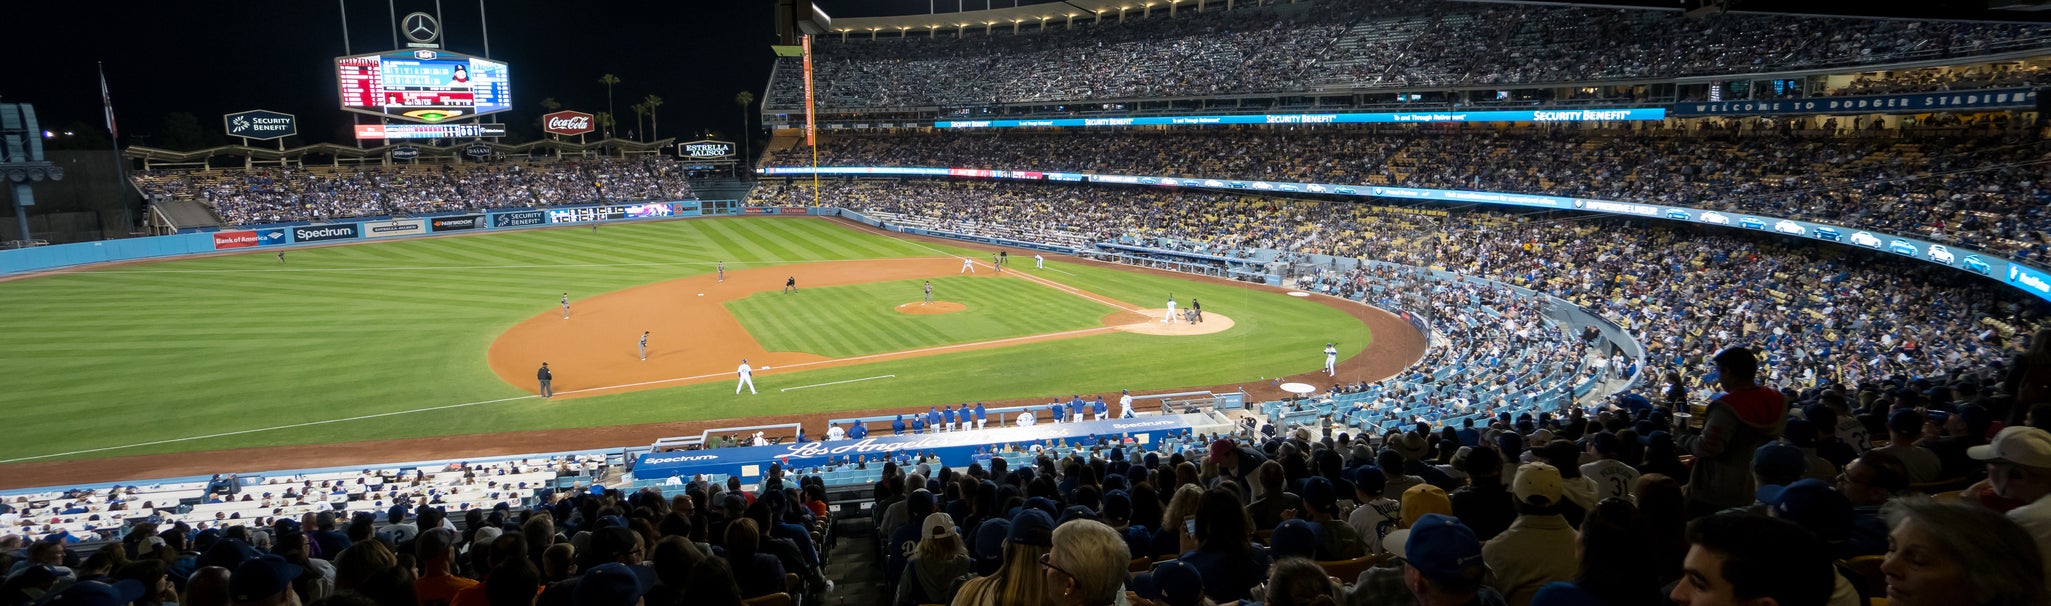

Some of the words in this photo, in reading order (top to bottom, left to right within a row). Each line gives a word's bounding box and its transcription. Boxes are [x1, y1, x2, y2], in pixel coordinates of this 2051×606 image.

[1696, 103, 1780, 112] WELCOME
[1795, 102, 1814, 110] TO
[1830, 98, 1909, 109] DODGER
[1925, 92, 2026, 106] STADIUM
[1266, 115, 1301, 123] SECURITY
[1301, 114, 1333, 122] BENEFIT
[1533, 111, 1581, 121] SECURITY
[1583, 110, 1626, 120] BENEFIT
[548, 116, 590, 130] Coca-Cola
[1085, 118, 1108, 126] SECURITY
[1109, 118, 1132, 126] BENEFIT
[240, 235, 268, 243] America
[297, 227, 351, 240] Spectrum
[1113, 420, 1169, 429] Spectrum
[774, 442, 829, 459] Los
[644, 454, 712, 465] Spectrum
[1610, 477, 1628, 497] 31
